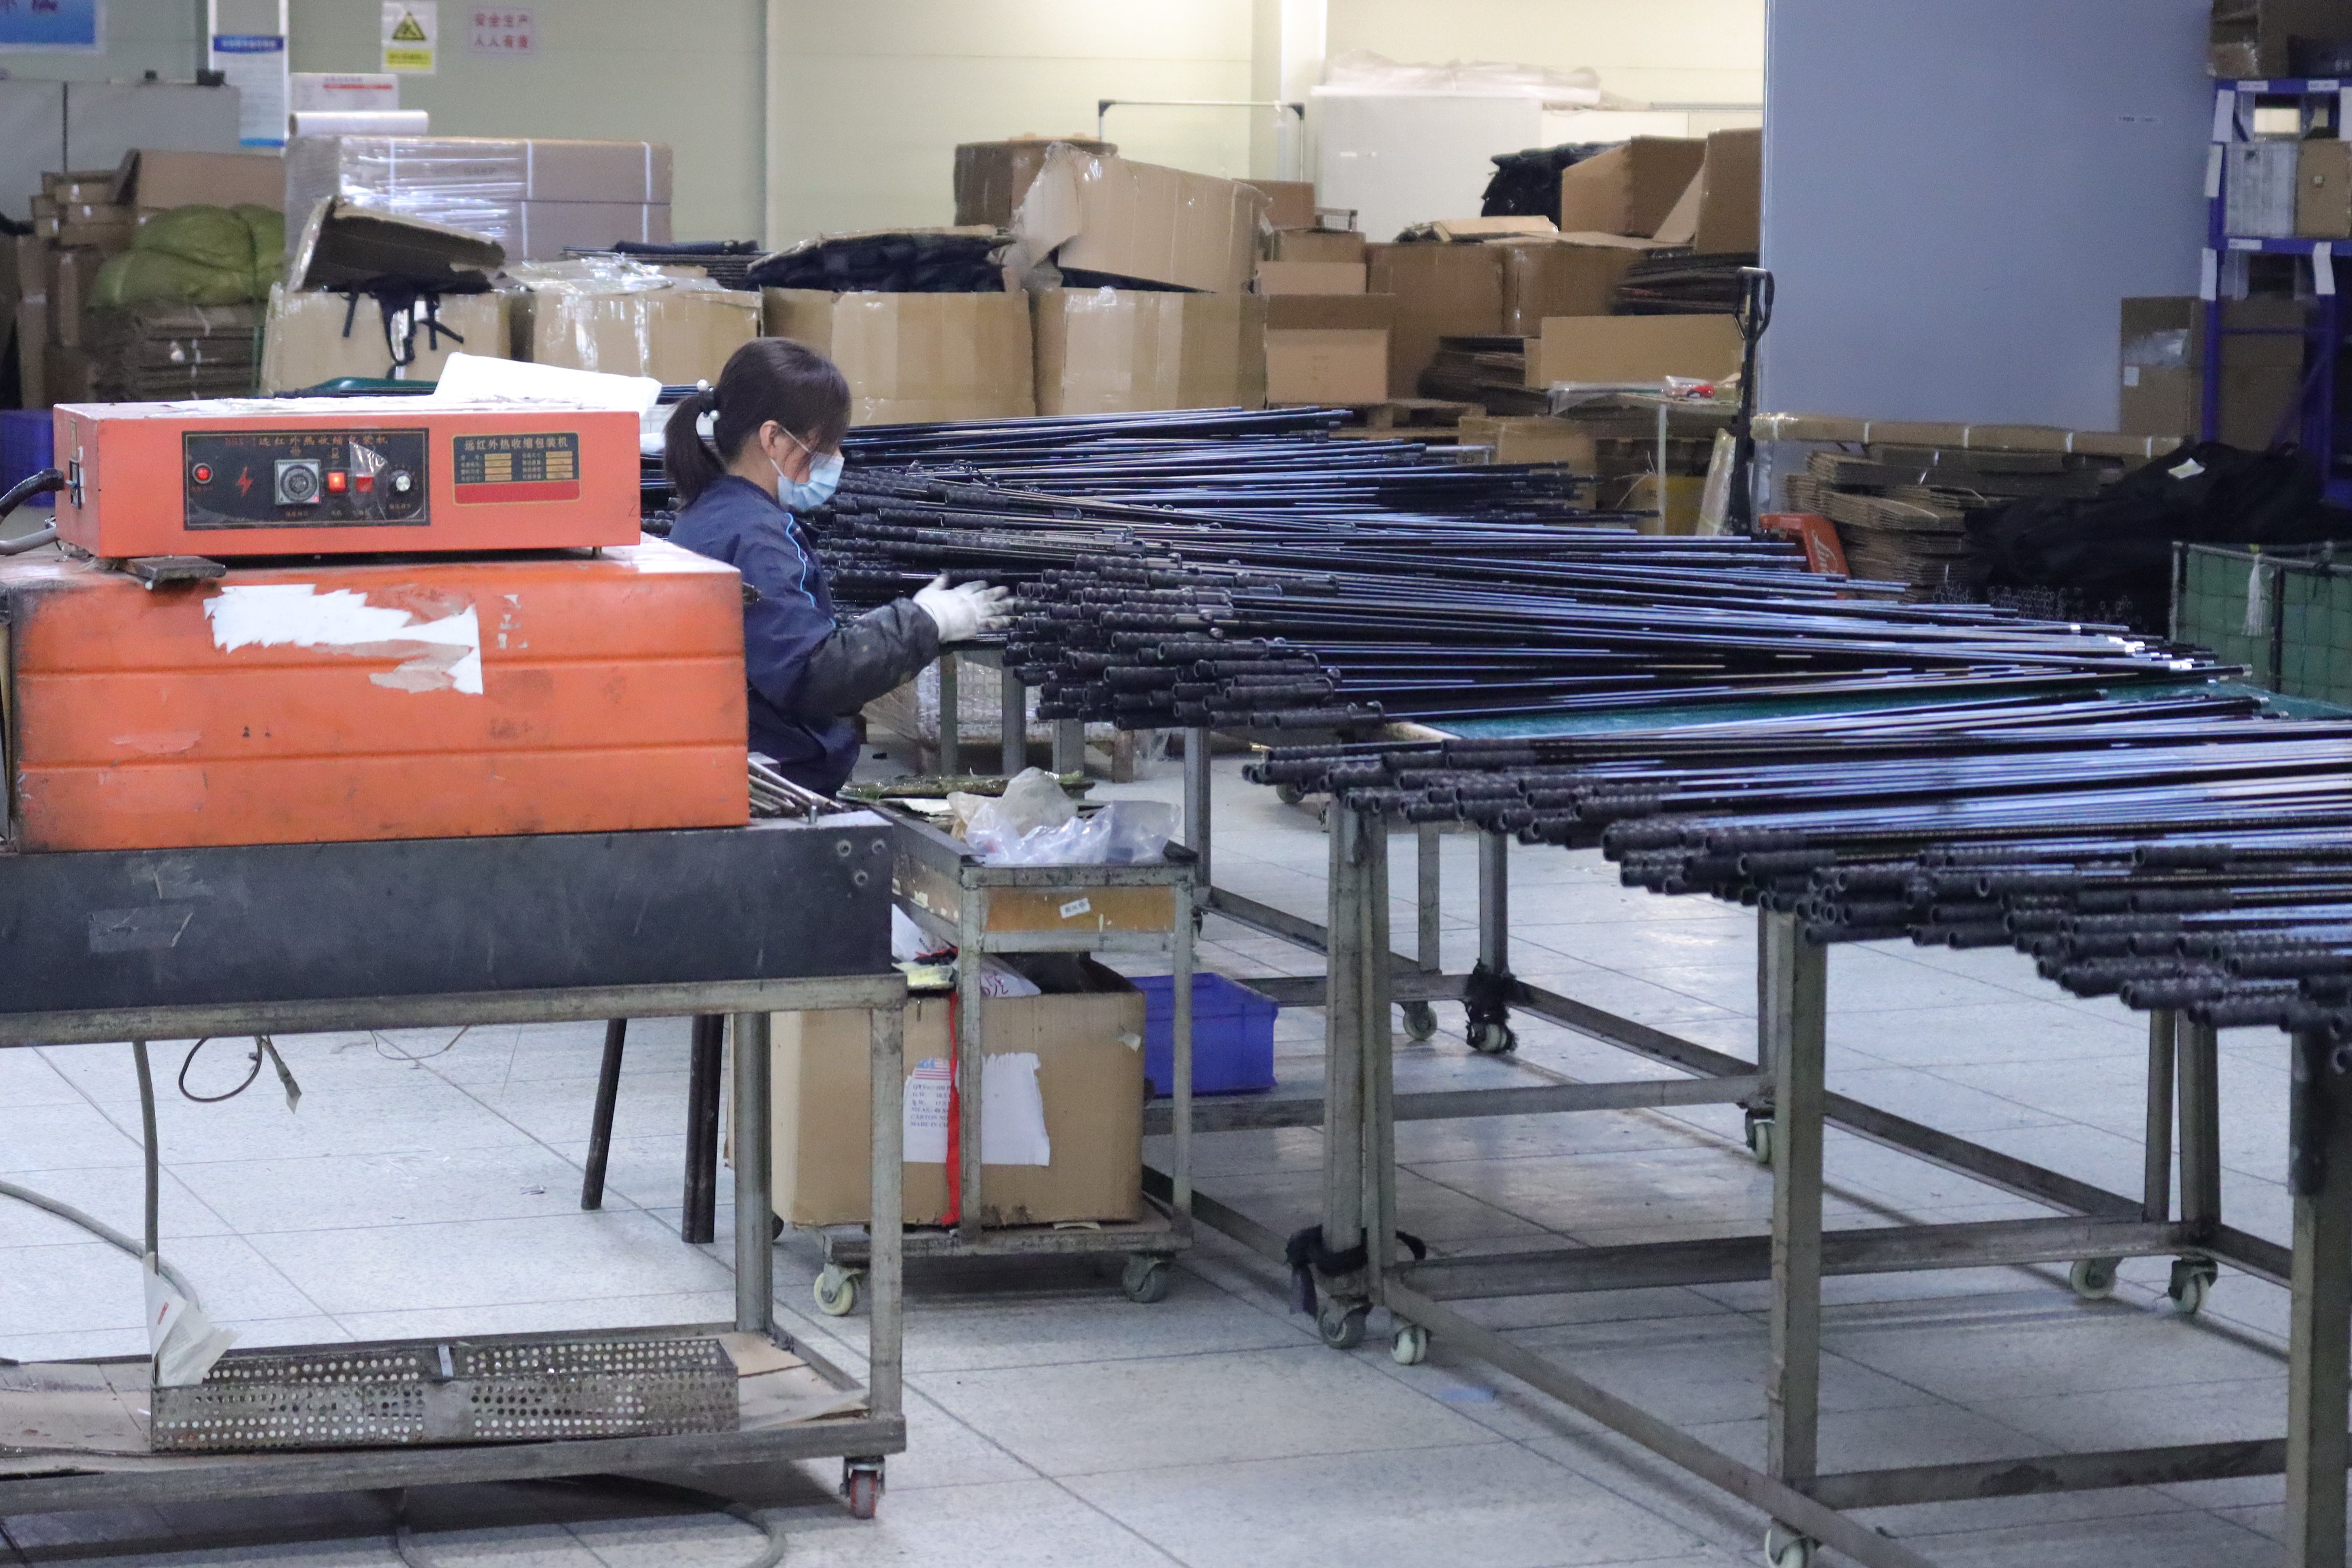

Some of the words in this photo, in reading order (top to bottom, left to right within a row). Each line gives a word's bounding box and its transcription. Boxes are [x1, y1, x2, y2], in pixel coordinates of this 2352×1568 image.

[465, 436, 568, 451] 远红外热收缩包装机
